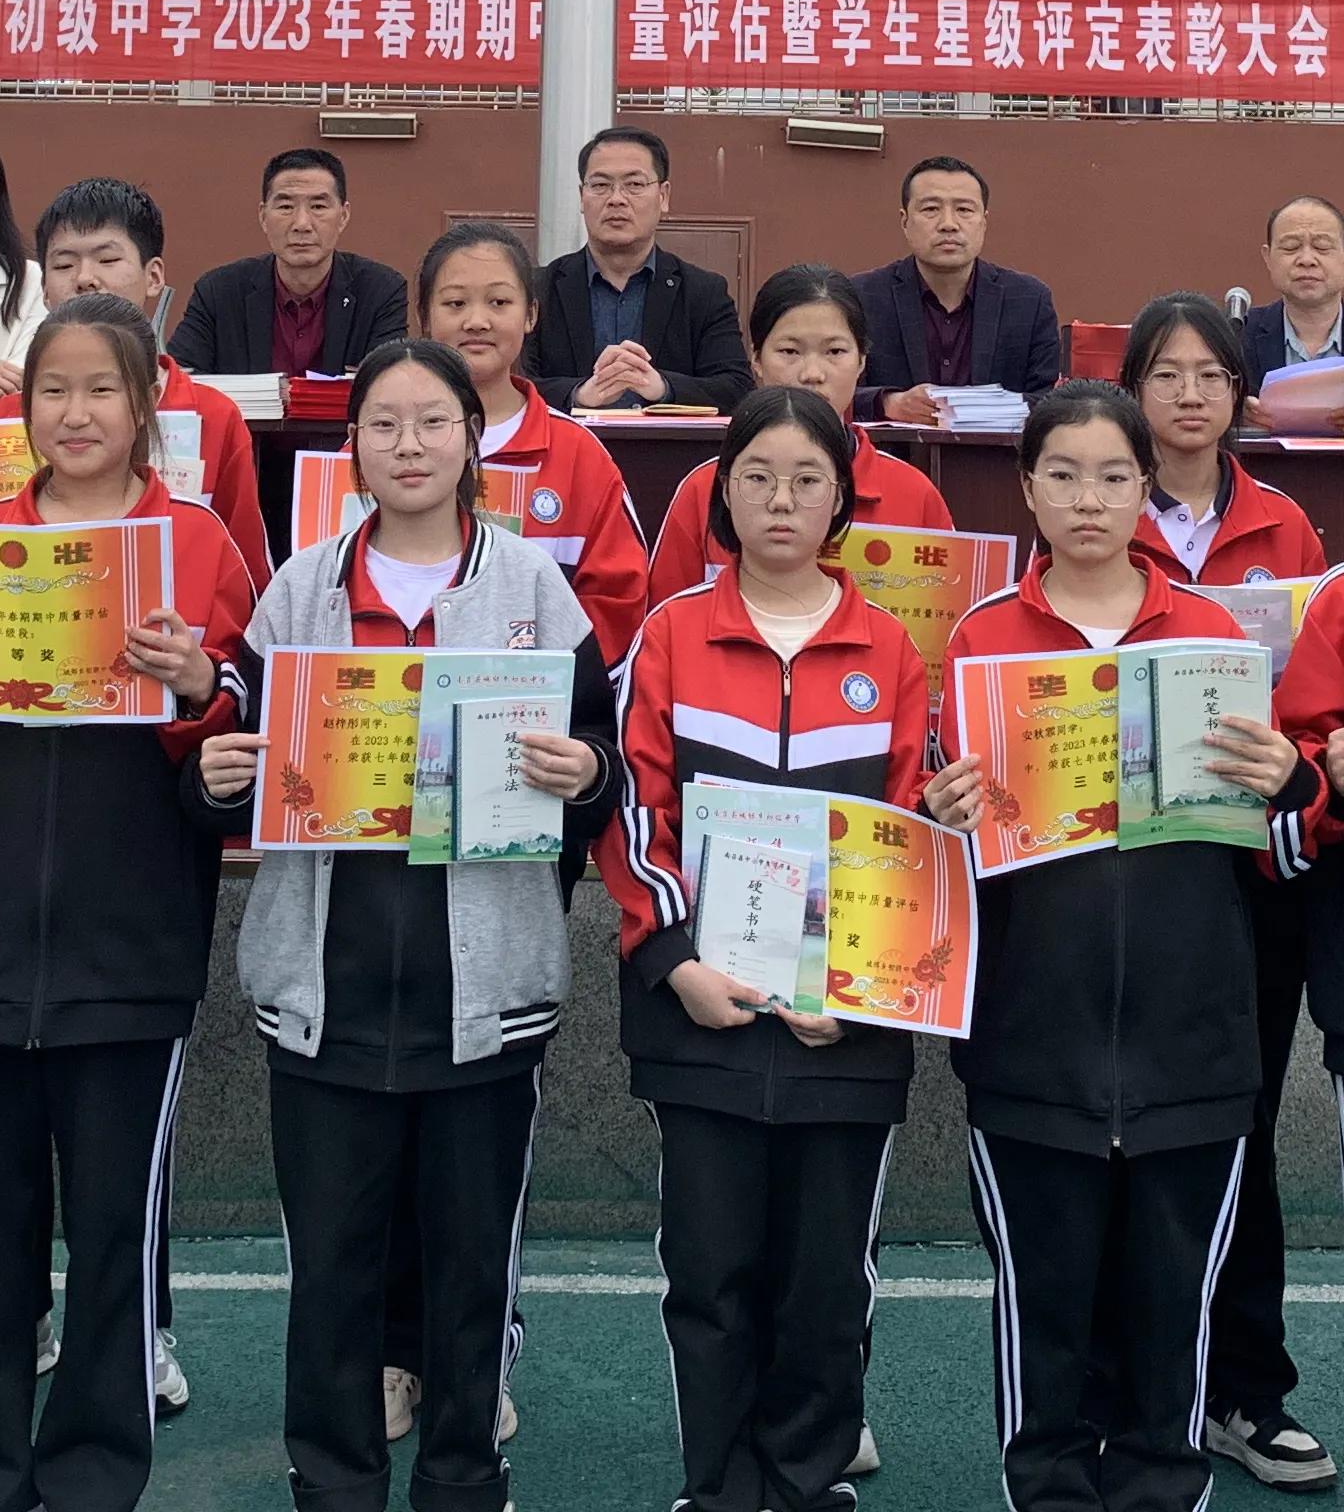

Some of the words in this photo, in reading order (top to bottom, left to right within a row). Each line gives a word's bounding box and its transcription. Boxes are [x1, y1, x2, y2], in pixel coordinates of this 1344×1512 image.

[1203, 687, 1221, 736] 硬笔书
[504, 731, 522, 792] 硬笔书法
[742, 879, 764, 943] 硬笔书法
